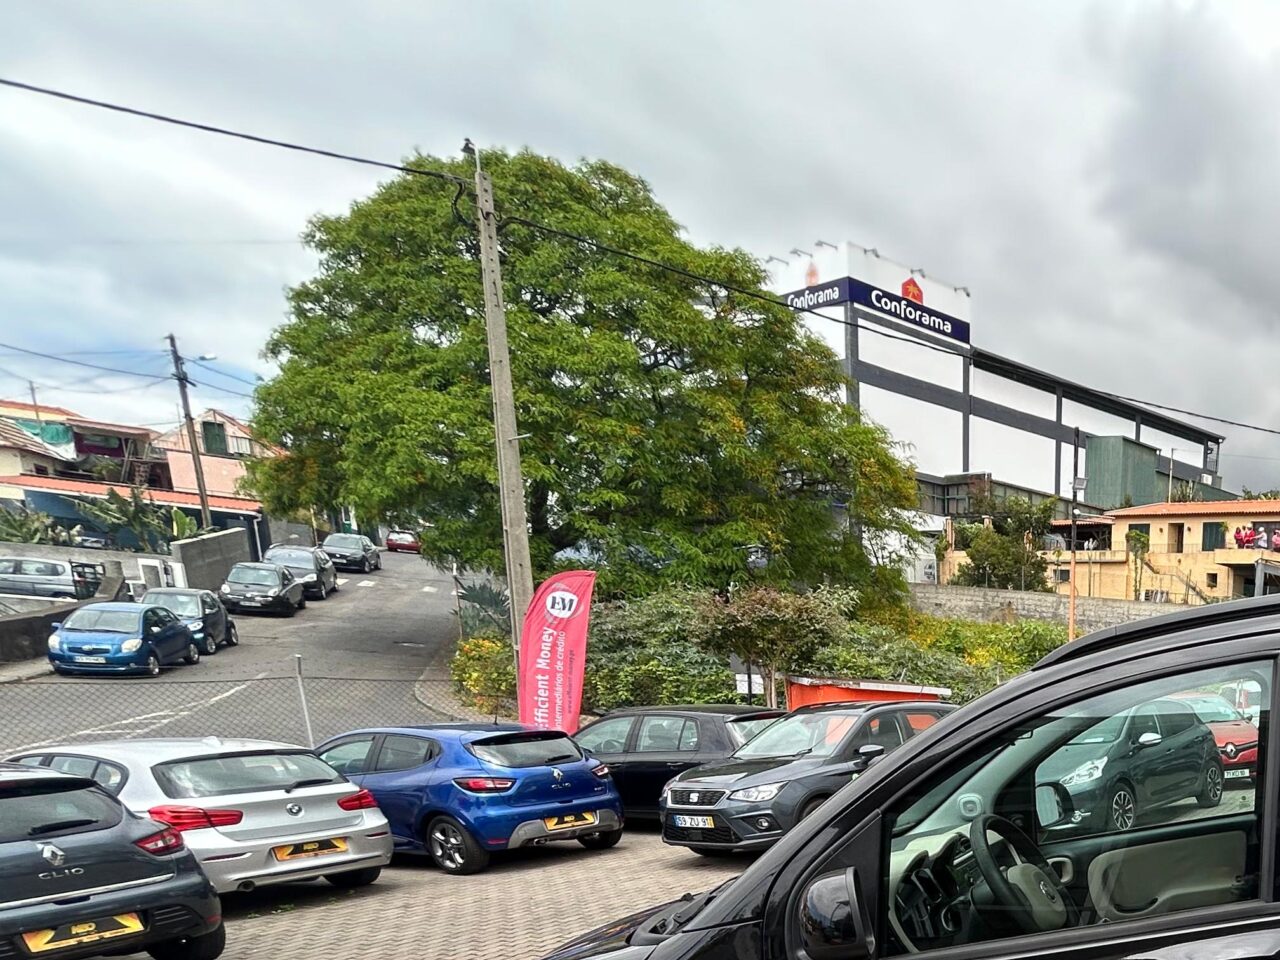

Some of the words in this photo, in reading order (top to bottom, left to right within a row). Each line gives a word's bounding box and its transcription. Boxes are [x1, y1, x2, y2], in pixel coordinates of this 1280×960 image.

[787, 286, 839, 310] Conforama
[871, 290, 952, 333] Conforama
[550, 595, 574, 612] EM
[536, 626, 557, 670] Money
[38, 867, 84, 879] CLIO
